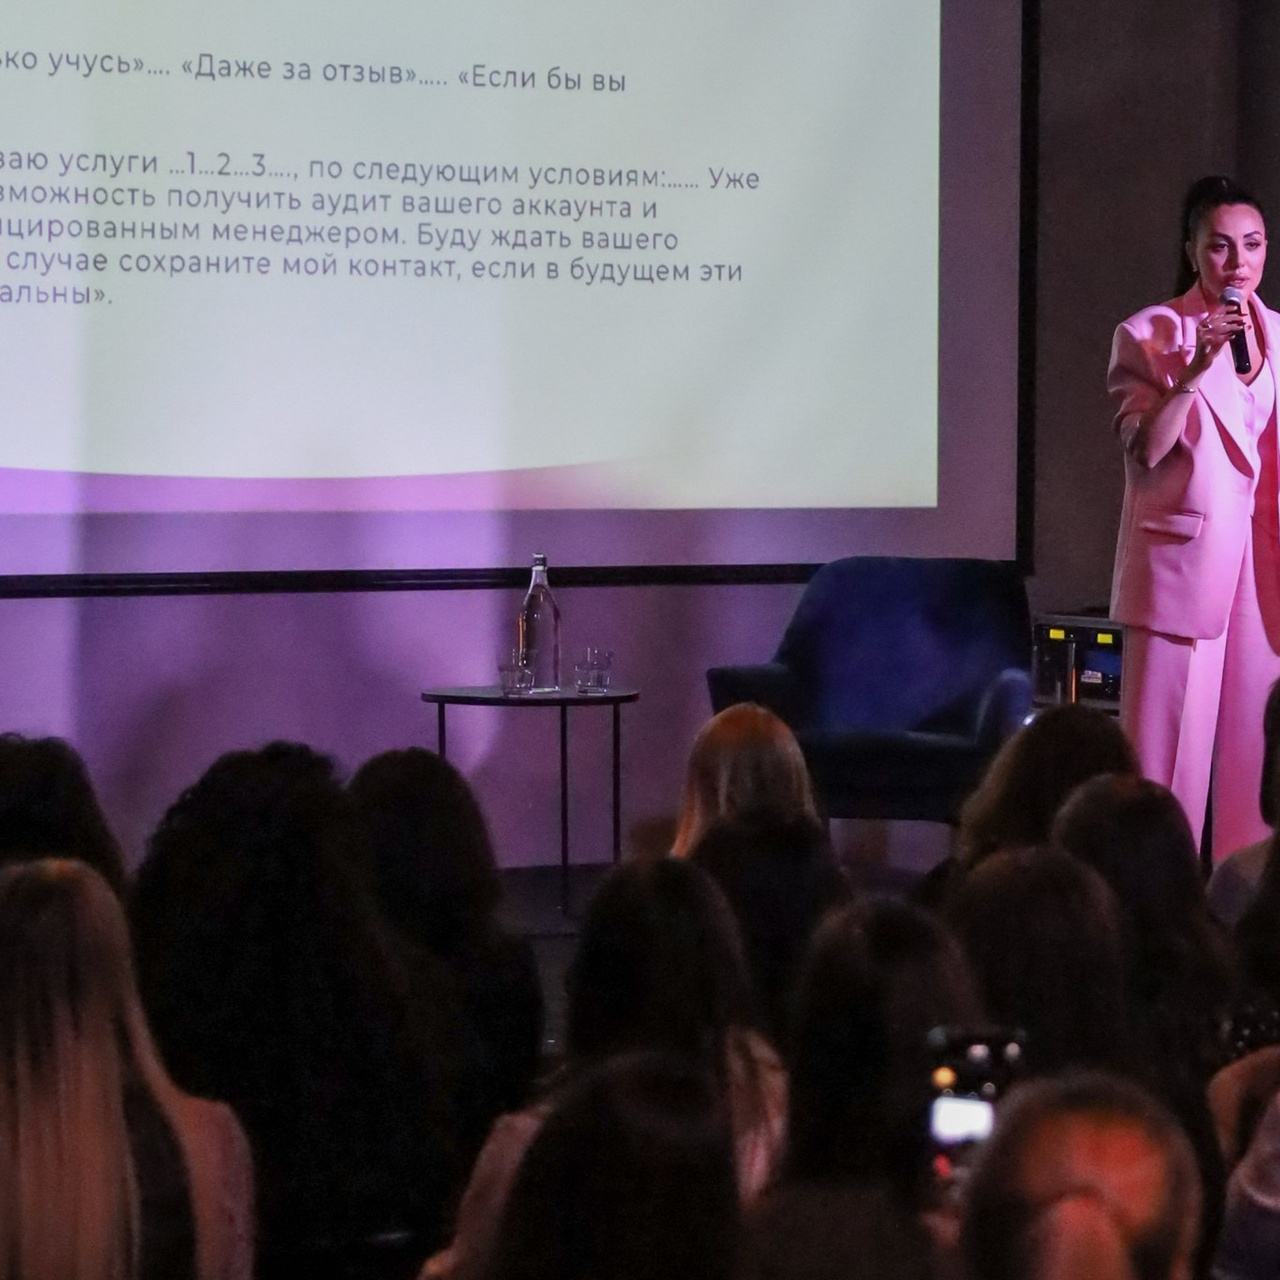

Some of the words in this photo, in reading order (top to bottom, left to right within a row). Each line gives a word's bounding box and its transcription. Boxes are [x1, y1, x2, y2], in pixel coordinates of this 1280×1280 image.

[0, 50, 38, 71] ко
[181, 52, 273, 82] «Даже
[282, 61, 312, 81] за
[458, 63, 536, 89] «Если
[546, 65, 582, 91] бы
[592, 73, 626, 93] вы
[58, 152, 158, 179] услуги
[309, 159, 343, 180] по
[352, 161, 519, 188] следующим
[707, 166, 760, 190] Уже
[167, 188, 302, 215] получить
[311, 192, 392, 218] аудит
[402, 194, 503, 216] вашего
[512, 197, 632, 223] аккаунта
[642, 200, 657, 219] и
[0, 217, 200, 243] цированным
[212, 222, 406, 250] менеджером.
[417, 221, 482, 253] Буду
[490, 228, 572, 251] ждать
[581, 230, 679, 251] вашего
[6, 250, 109, 277] случае
[118, 253, 271, 279] сохраните
[282, 252, 337, 276] мой
[348, 258, 462, 282] контакт,
[471, 260, 536, 279] если
[546, 261, 560, 280] в
[569, 255, 690, 287] будущем
[699, 263, 742, 282] эти
[0, 284, 113, 305] альны».
